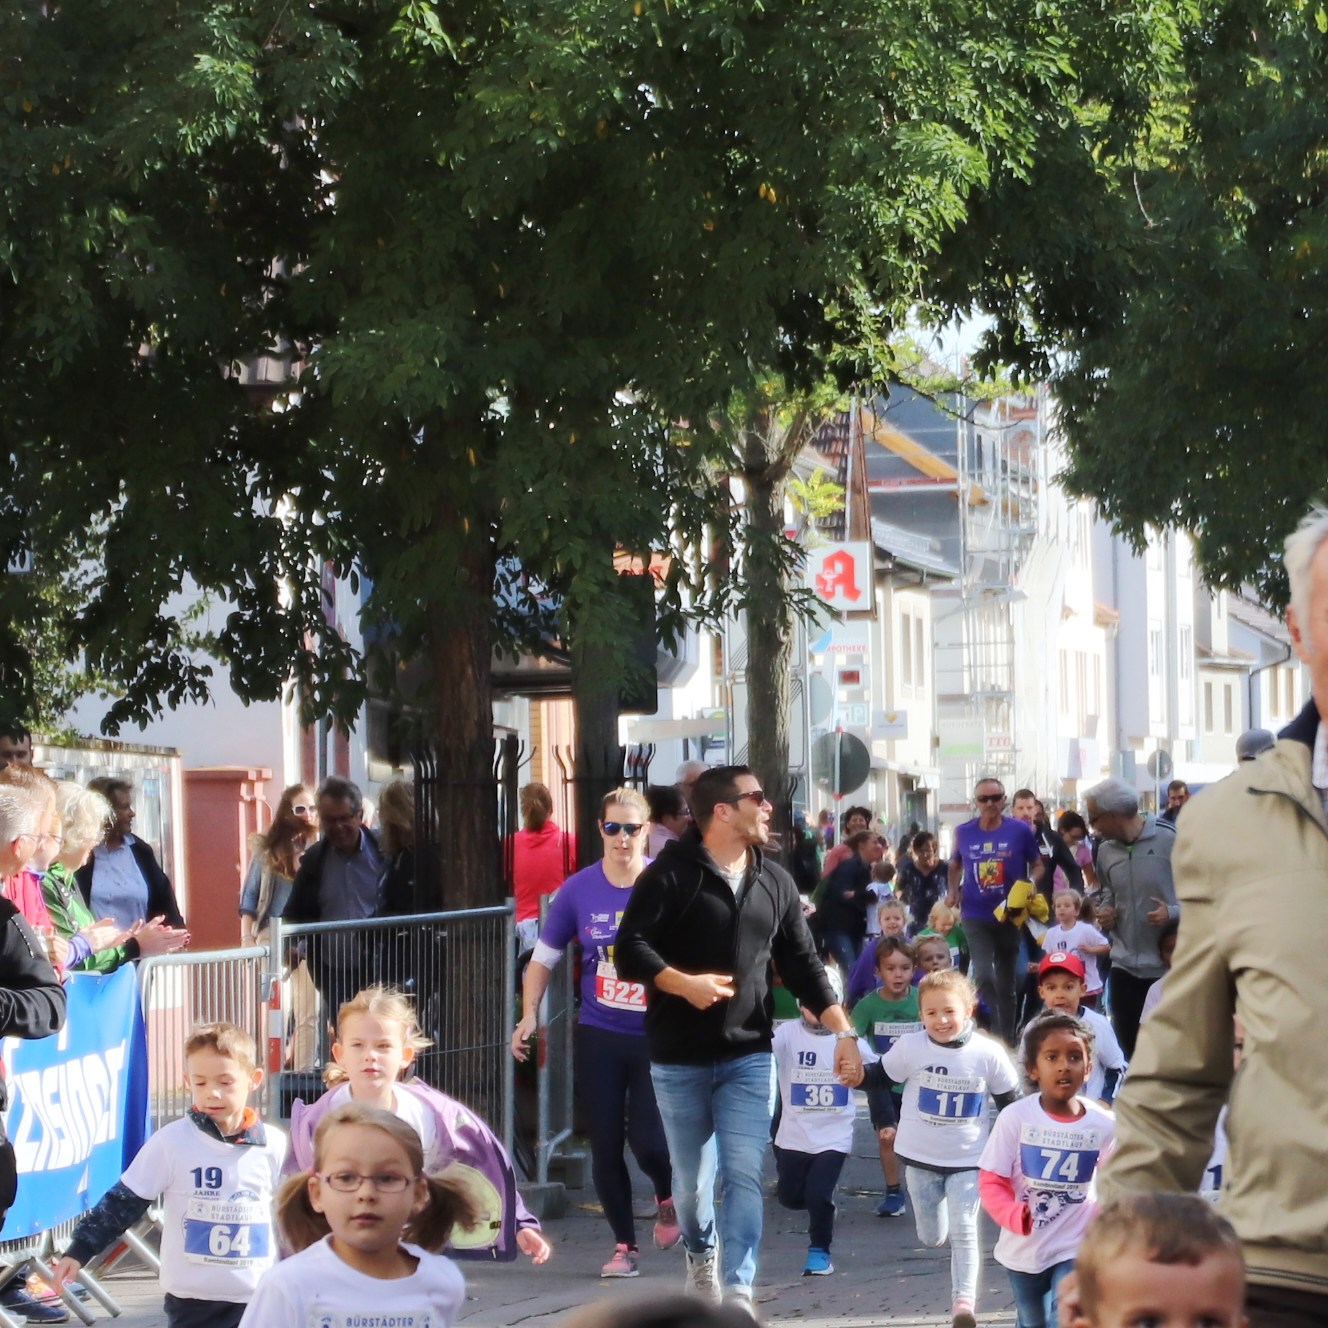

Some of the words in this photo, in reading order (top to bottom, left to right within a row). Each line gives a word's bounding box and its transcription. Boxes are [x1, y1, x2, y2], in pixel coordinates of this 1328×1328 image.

[602, 979, 645, 1005] 522
[797, 1051, 817, 1067] 19
[805, 1085, 834, 1107] 36
[936, 1092, 965, 1117] 11
[190, 1166, 222, 1189] 19
[1040, 1149, 1079, 1182] 74
[208, 1225, 251, 1257] 64
[346, 1315, 414, 1328] BÜRSTÄDTER
